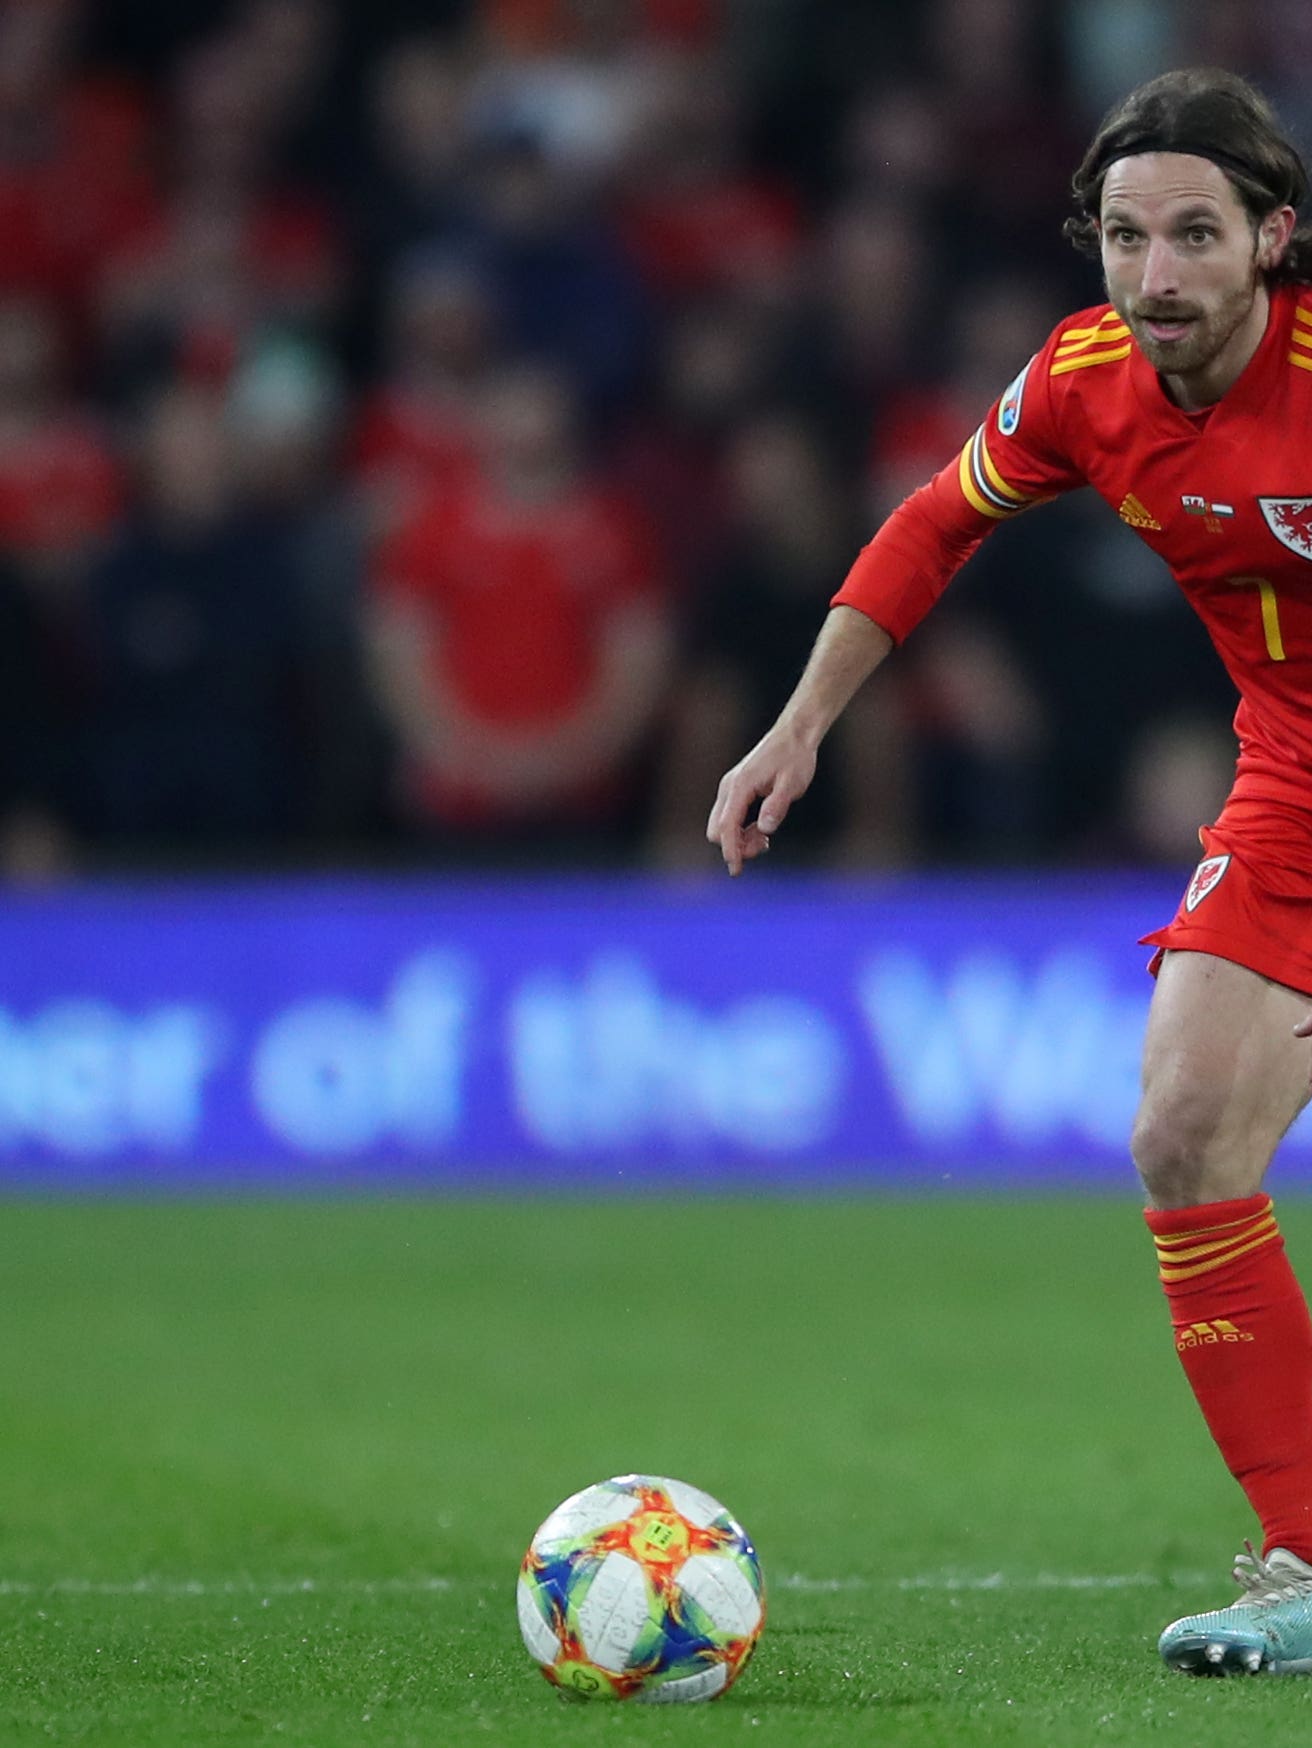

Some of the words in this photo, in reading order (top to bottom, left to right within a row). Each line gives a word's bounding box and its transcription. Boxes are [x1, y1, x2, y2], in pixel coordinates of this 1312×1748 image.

[1225, 576, 1286, 661] 7
[253, 947, 470, 1153] of
[510, 950, 841, 1153] the
